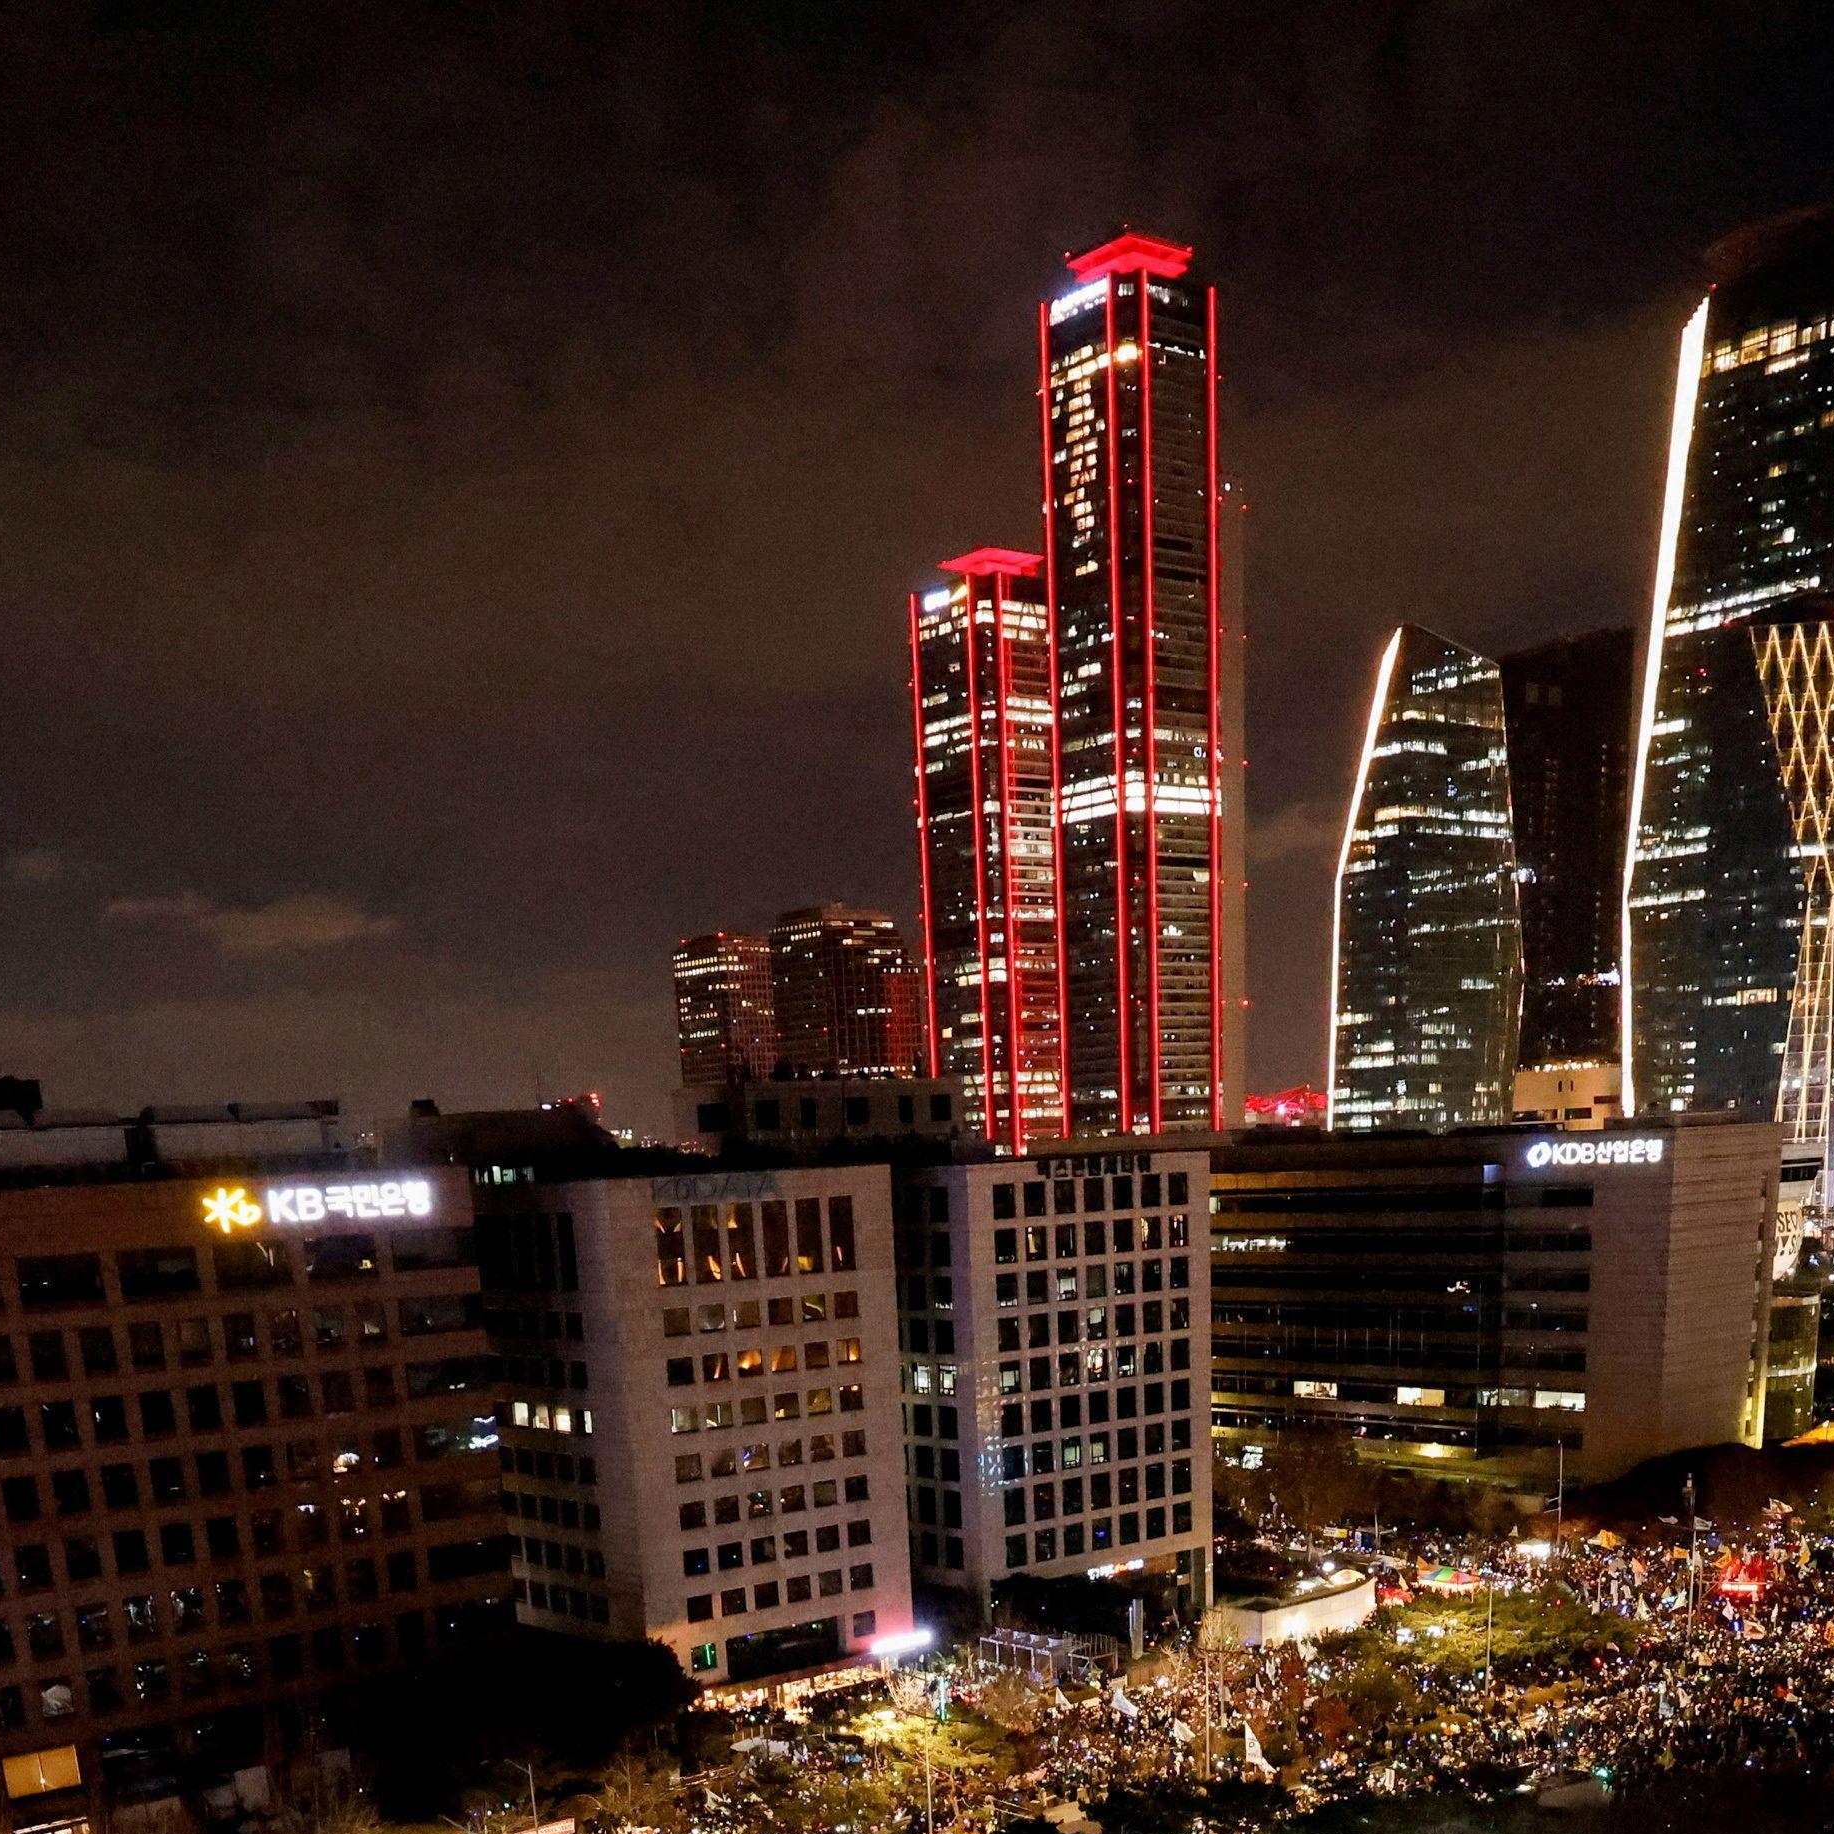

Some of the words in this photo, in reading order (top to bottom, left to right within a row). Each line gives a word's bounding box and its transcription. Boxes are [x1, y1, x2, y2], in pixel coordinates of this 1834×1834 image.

[1552, 1141, 1596, 1165] KDB
[1596, 1138, 1664, 1164] 산업은행
[267, 1187, 325, 1223] KB
[324, 1180, 431, 1218] 국민은행
